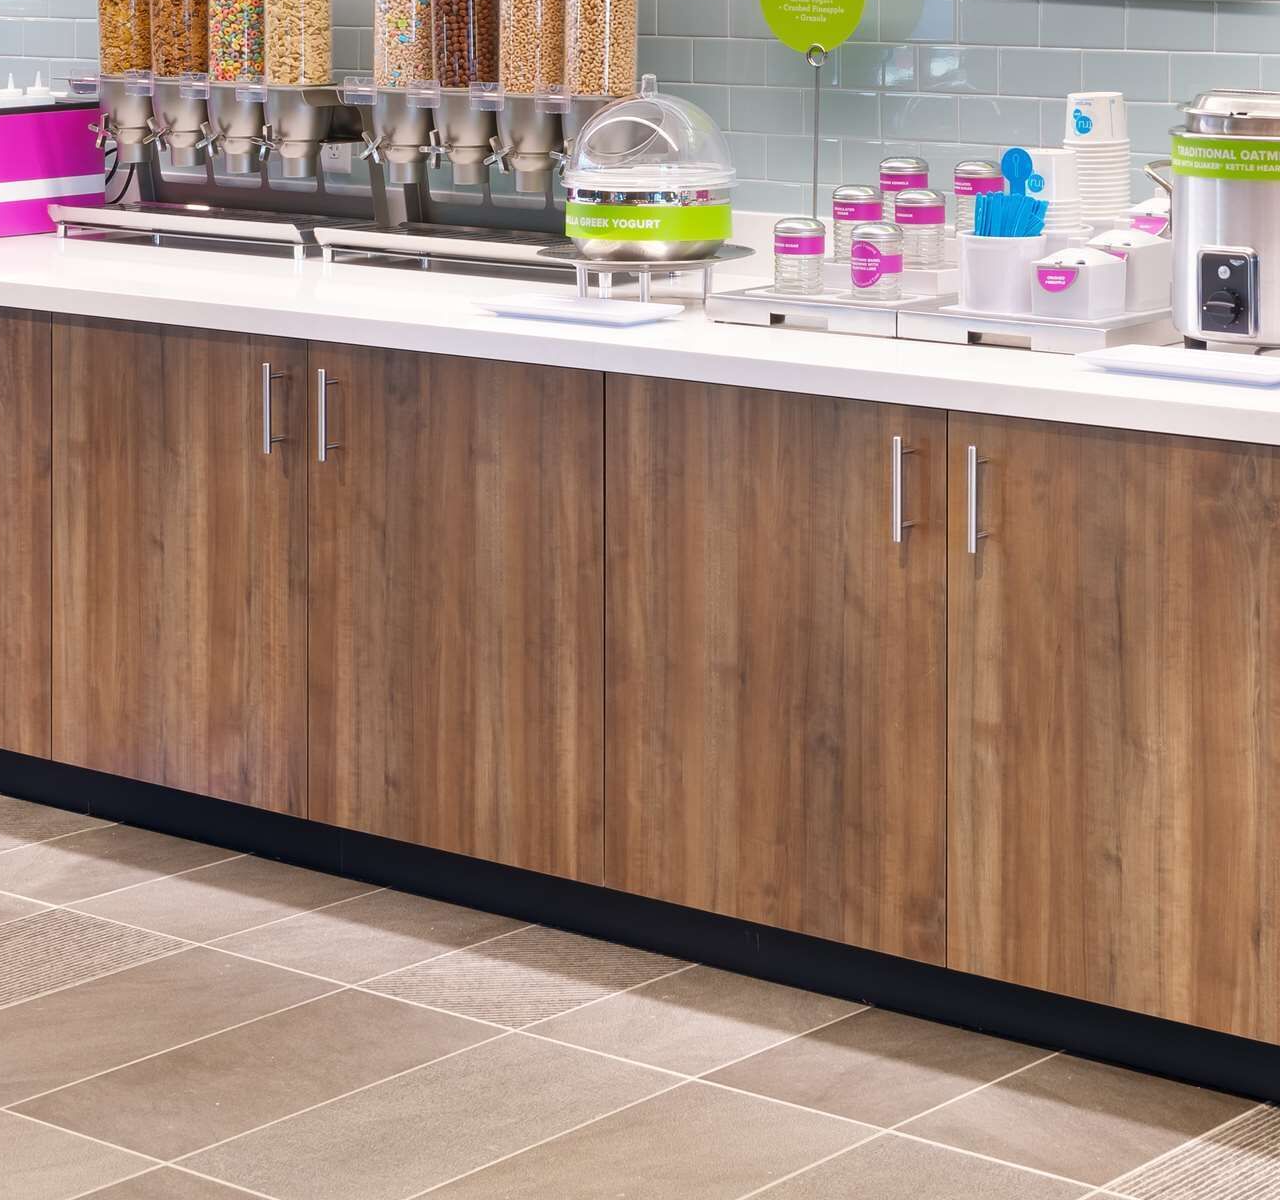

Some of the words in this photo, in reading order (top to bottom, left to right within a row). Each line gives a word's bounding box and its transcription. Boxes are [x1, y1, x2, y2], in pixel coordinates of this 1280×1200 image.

[1178, 145, 1237, 160] TRADITIONAL
[1225, 163, 1256, 171] KETTLE
[580, 217, 608, 227] GREEK
[611, 218, 661, 229] YOGURT
